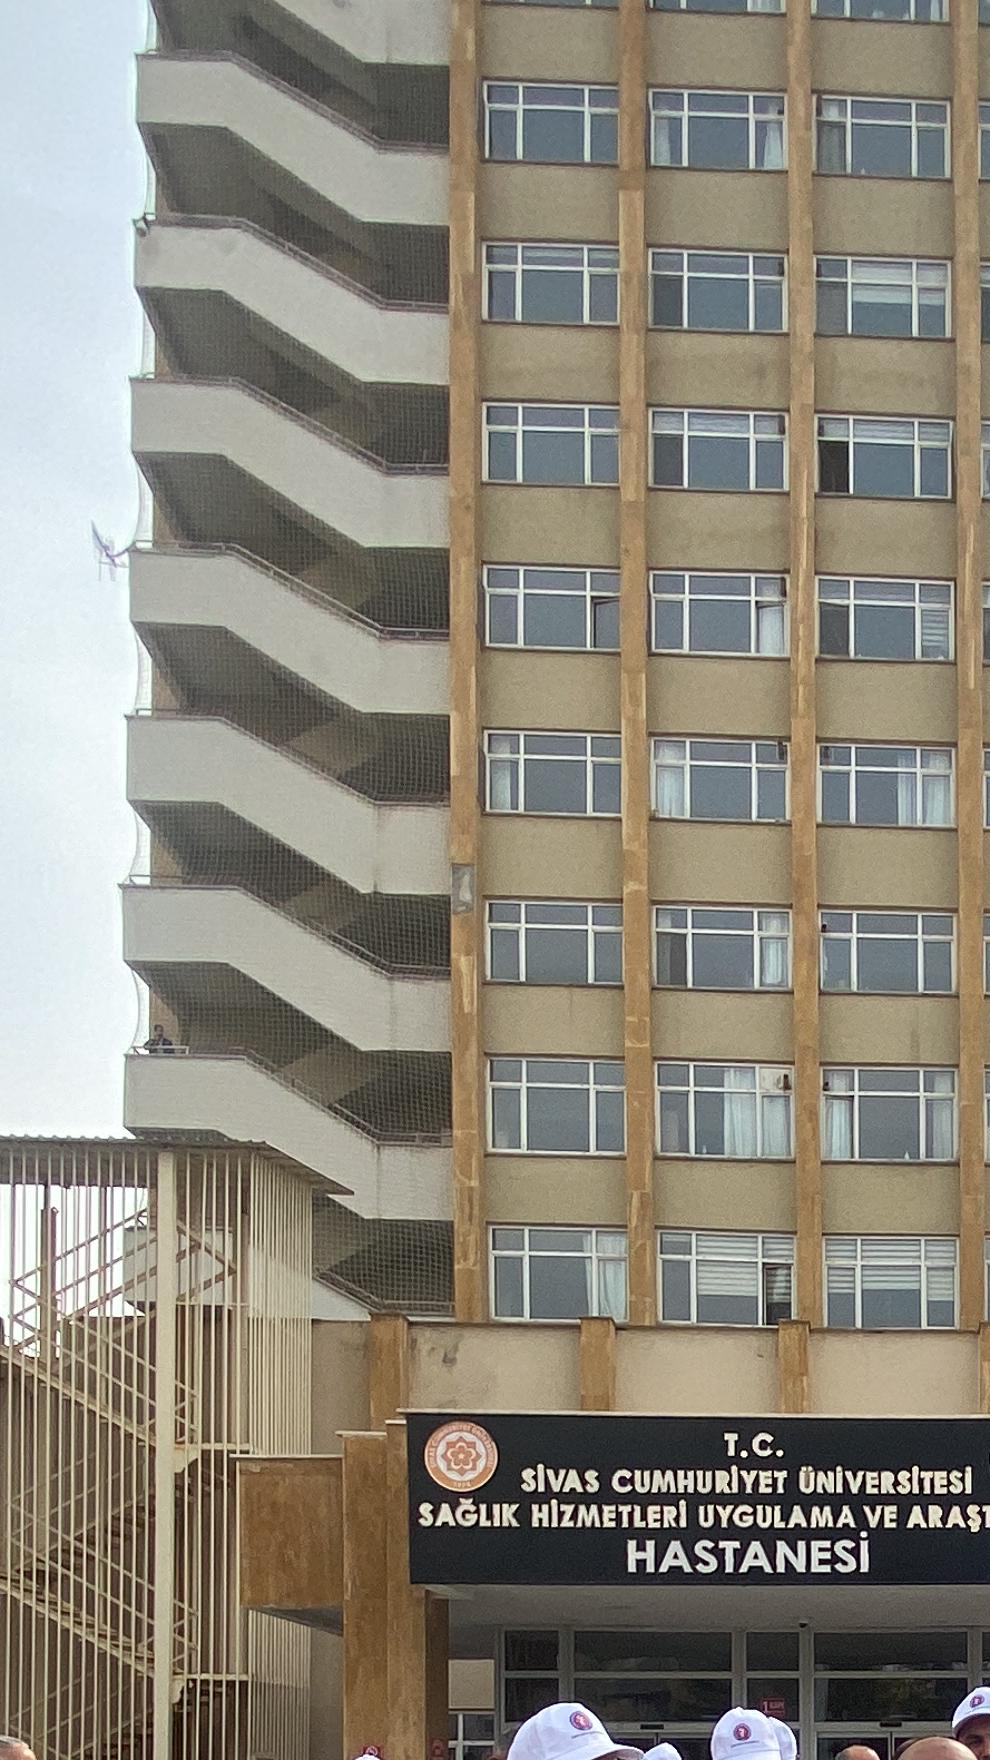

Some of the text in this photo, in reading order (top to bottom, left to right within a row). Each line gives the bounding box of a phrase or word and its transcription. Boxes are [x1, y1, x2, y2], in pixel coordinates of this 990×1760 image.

[724, 1432, 785, 1458] T.C.
[520, 1463, 973, 1494] SİVAS CUMHURİYET ÜNİVERSİTESİ
[418, 1497, 521, 1528] SAĞLIK
[531, 1499, 687, 1528] HİZMETLERİ
[699, 1504, 857, 1529] UYGULAMA
[863, 1504, 898, 1528] VE
[627, 1531, 870, 1574] HASTANESİ
